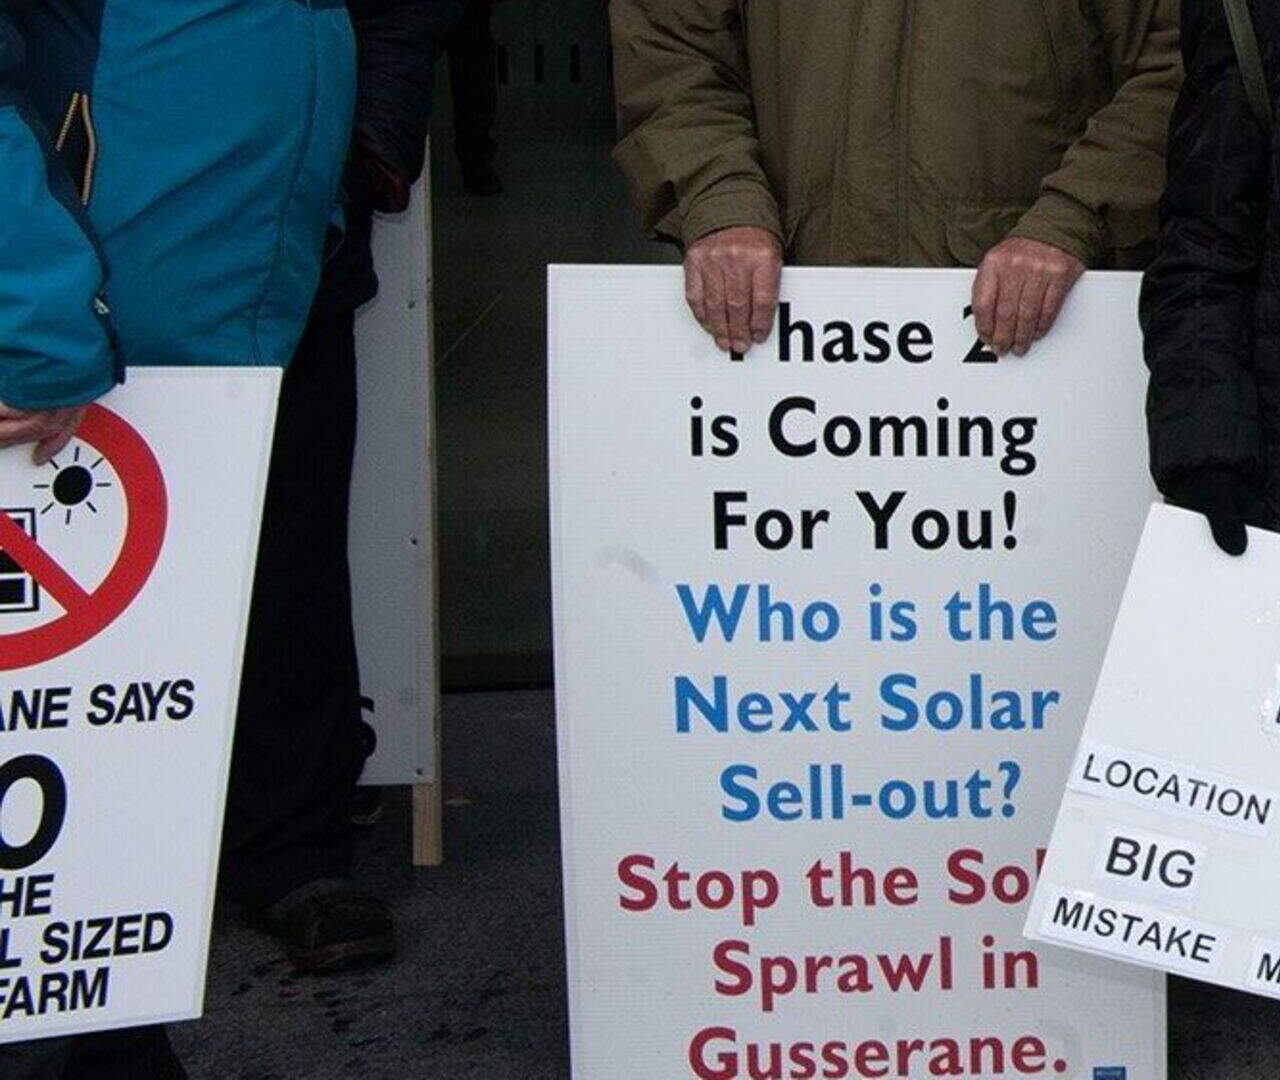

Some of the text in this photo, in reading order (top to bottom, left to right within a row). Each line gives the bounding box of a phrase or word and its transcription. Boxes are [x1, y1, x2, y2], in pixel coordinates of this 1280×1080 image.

[729, 302, 933, 363] hase
[689, 396, 1038, 475] is Coming
[713, 490, 1019, 552] For You!
[676, 581, 1058, 643] Who is the
[87, 679, 195, 726] SAYS
[674, 672, 1059, 734] Next Solar
[720, 761, 1021, 823] Sell-out?
[1082, 753, 1271, 825] LOCATION
[617, 855, 779, 924] Stop
[807, 852, 918, 906] the
[1104, 836, 1197, 890] BIG
[40, 911, 174, 966] SIZED
[1052, 896, 1216, 964] MISTAKE
[712, 935, 1040, 1011] Sprawl in
[688, 1025, 1066, 1079] Gusserane.
